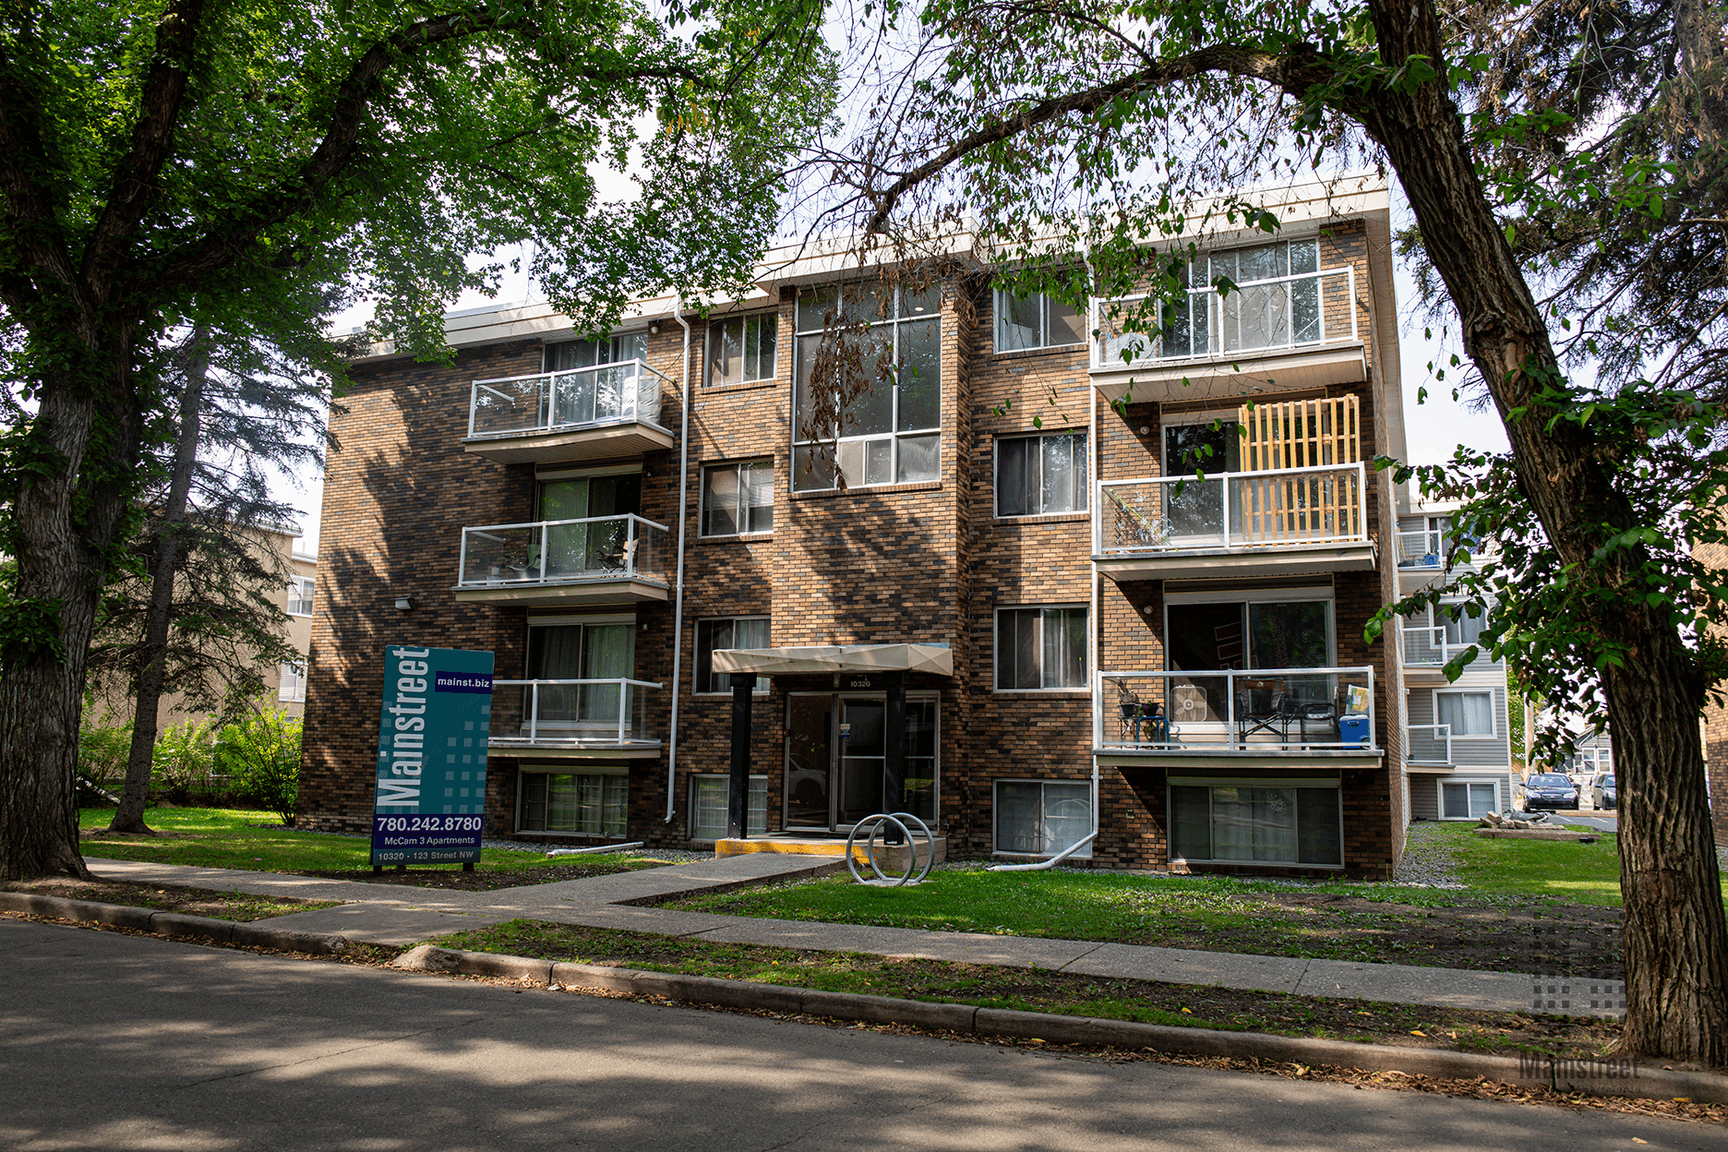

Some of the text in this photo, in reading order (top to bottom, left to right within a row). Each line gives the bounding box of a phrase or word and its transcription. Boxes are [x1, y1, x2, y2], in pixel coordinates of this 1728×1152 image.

[437, 677, 490, 688] mainst.biz
[376, 647, 430, 807] Mainstreet
[377, 817, 482, 831] 780.242.8780
[384, 837, 475, 846] McCam 3 Apartments
[378, 852, 405, 860] 10320
[413, 852, 428, 860] 123
[430, 851, 457, 859] Street
